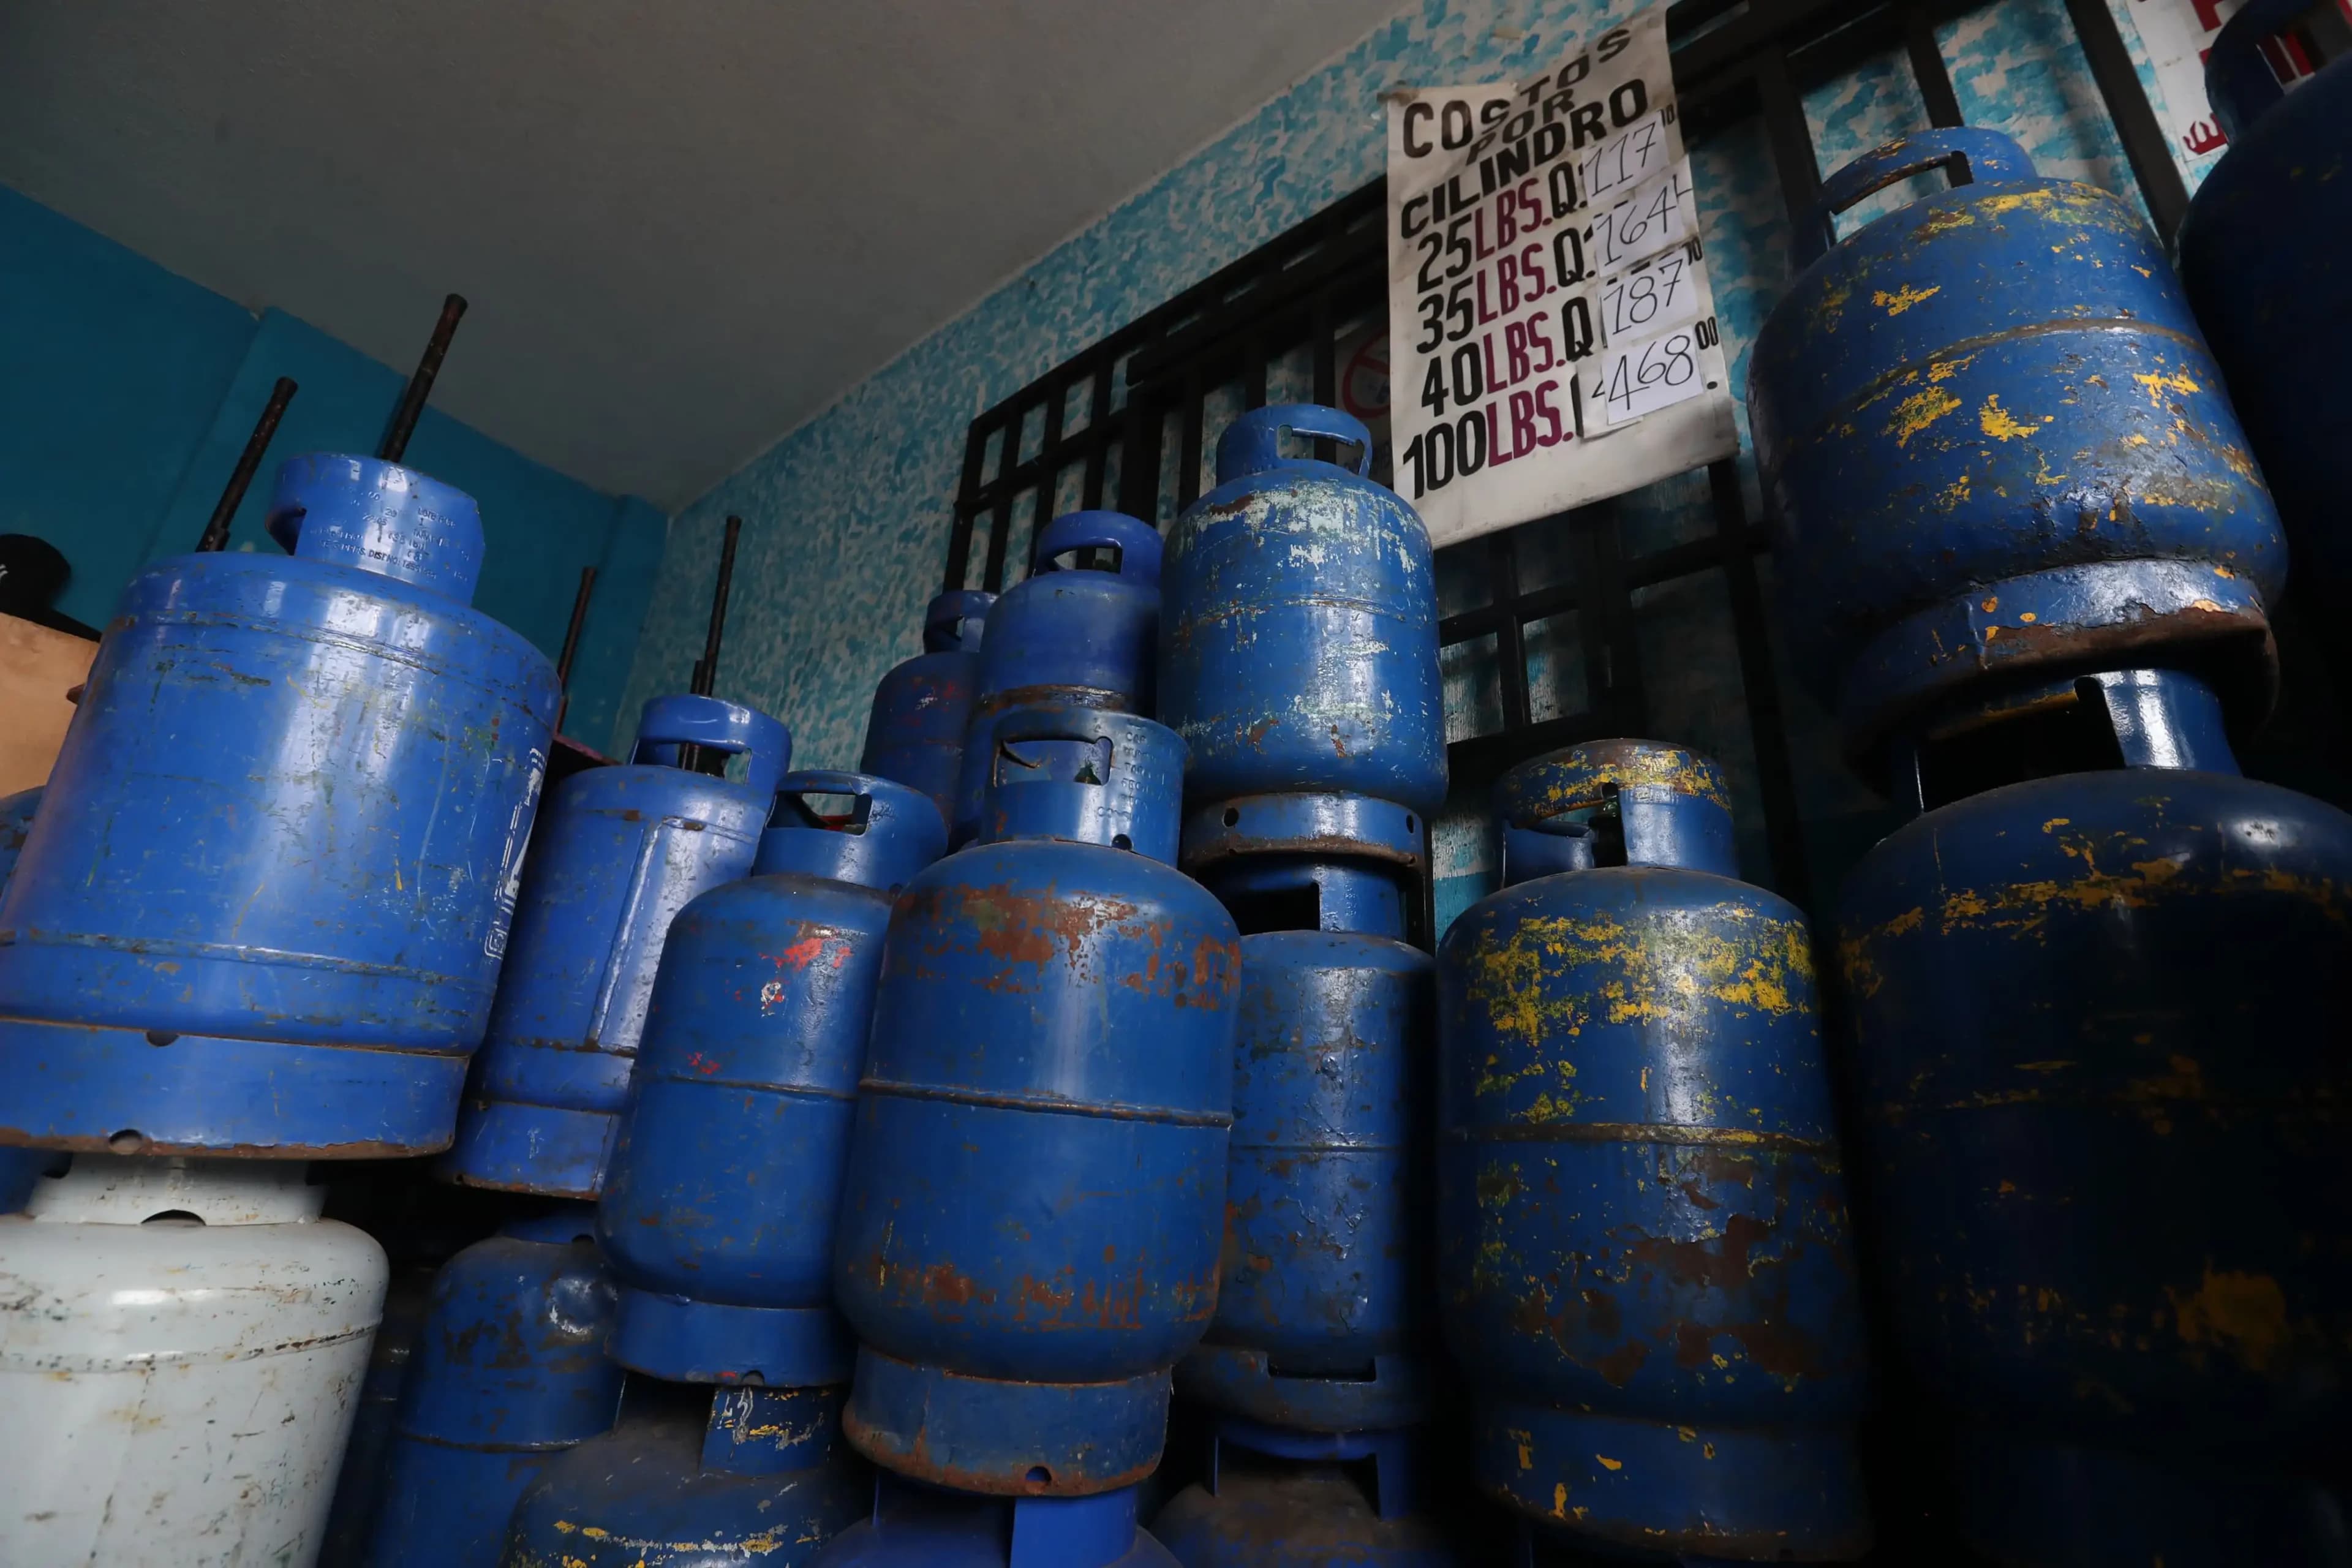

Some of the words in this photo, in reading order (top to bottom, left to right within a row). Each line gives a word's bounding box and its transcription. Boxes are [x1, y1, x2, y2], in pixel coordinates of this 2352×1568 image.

[1403, 29, 1631, 158] COSTOS
[1466, 88, 1576, 167] POR
[1401, 78, 1648, 239] CILINDRO
[1585, 121, 1656, 197] 117
[1596, 185, 1676, 266] 164
[1603, 258, 1683, 334] 187
[1608, 334, 1694, 411] 468
